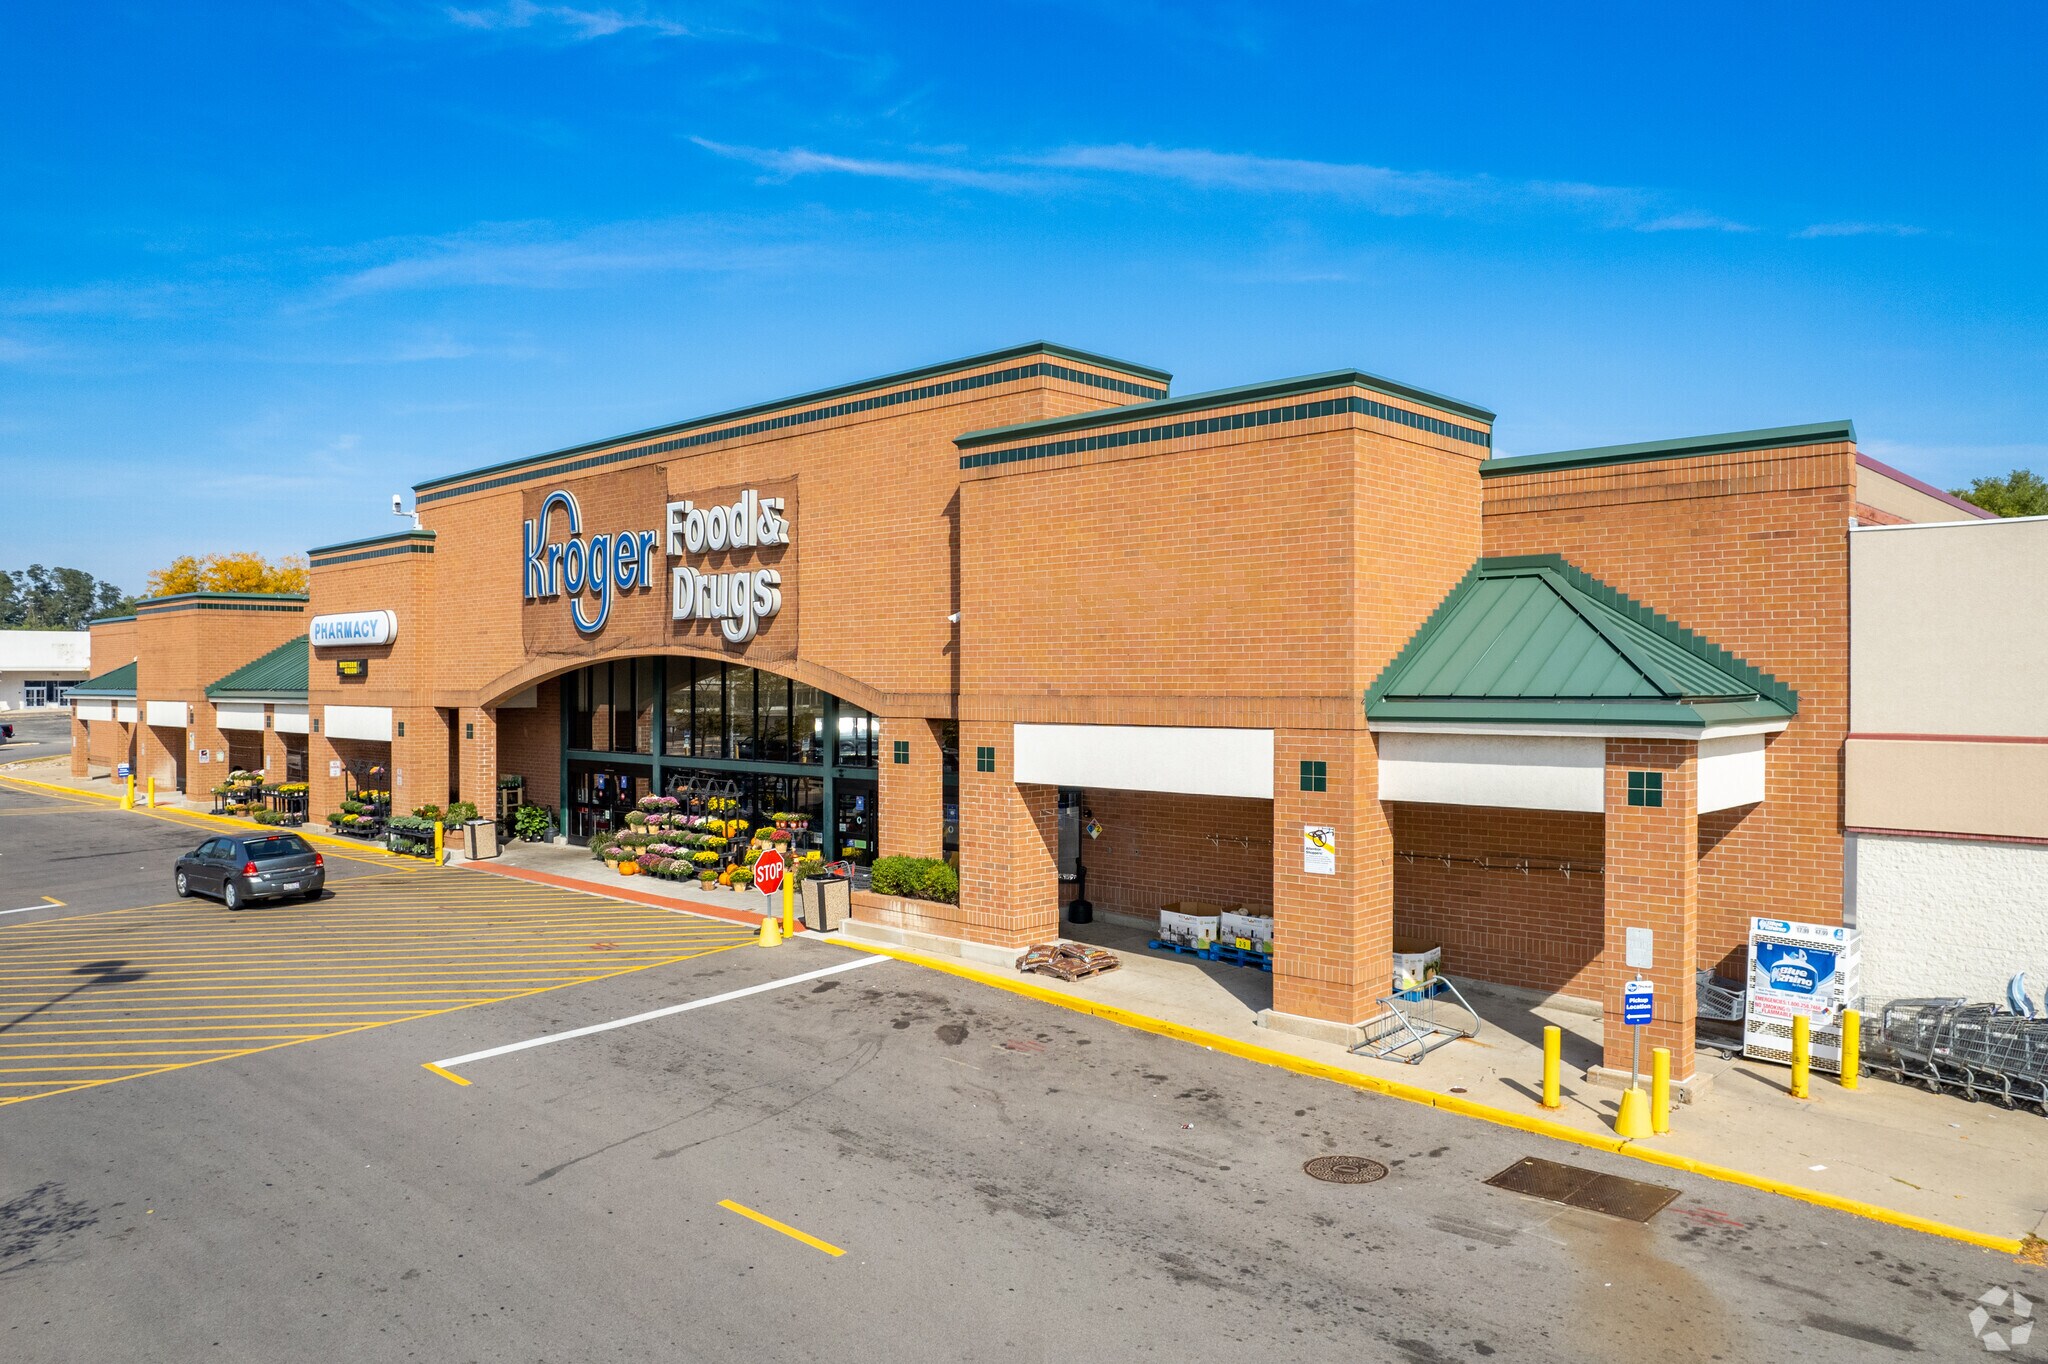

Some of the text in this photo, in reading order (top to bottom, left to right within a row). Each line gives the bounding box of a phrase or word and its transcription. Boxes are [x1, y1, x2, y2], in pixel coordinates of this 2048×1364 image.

[666, 489, 790, 556] Food &
[524, 489, 660, 632] Kroger
[672, 566, 782, 643] Drugs
[314, 619, 378, 639] PHARMACY
[757, 862, 782, 882] STOP
[1776, 975, 1813, 987] Rhino
[1780, 966, 1807, 978] Blue
[1761, 1008, 1792, 1017] FLAMMABLE
